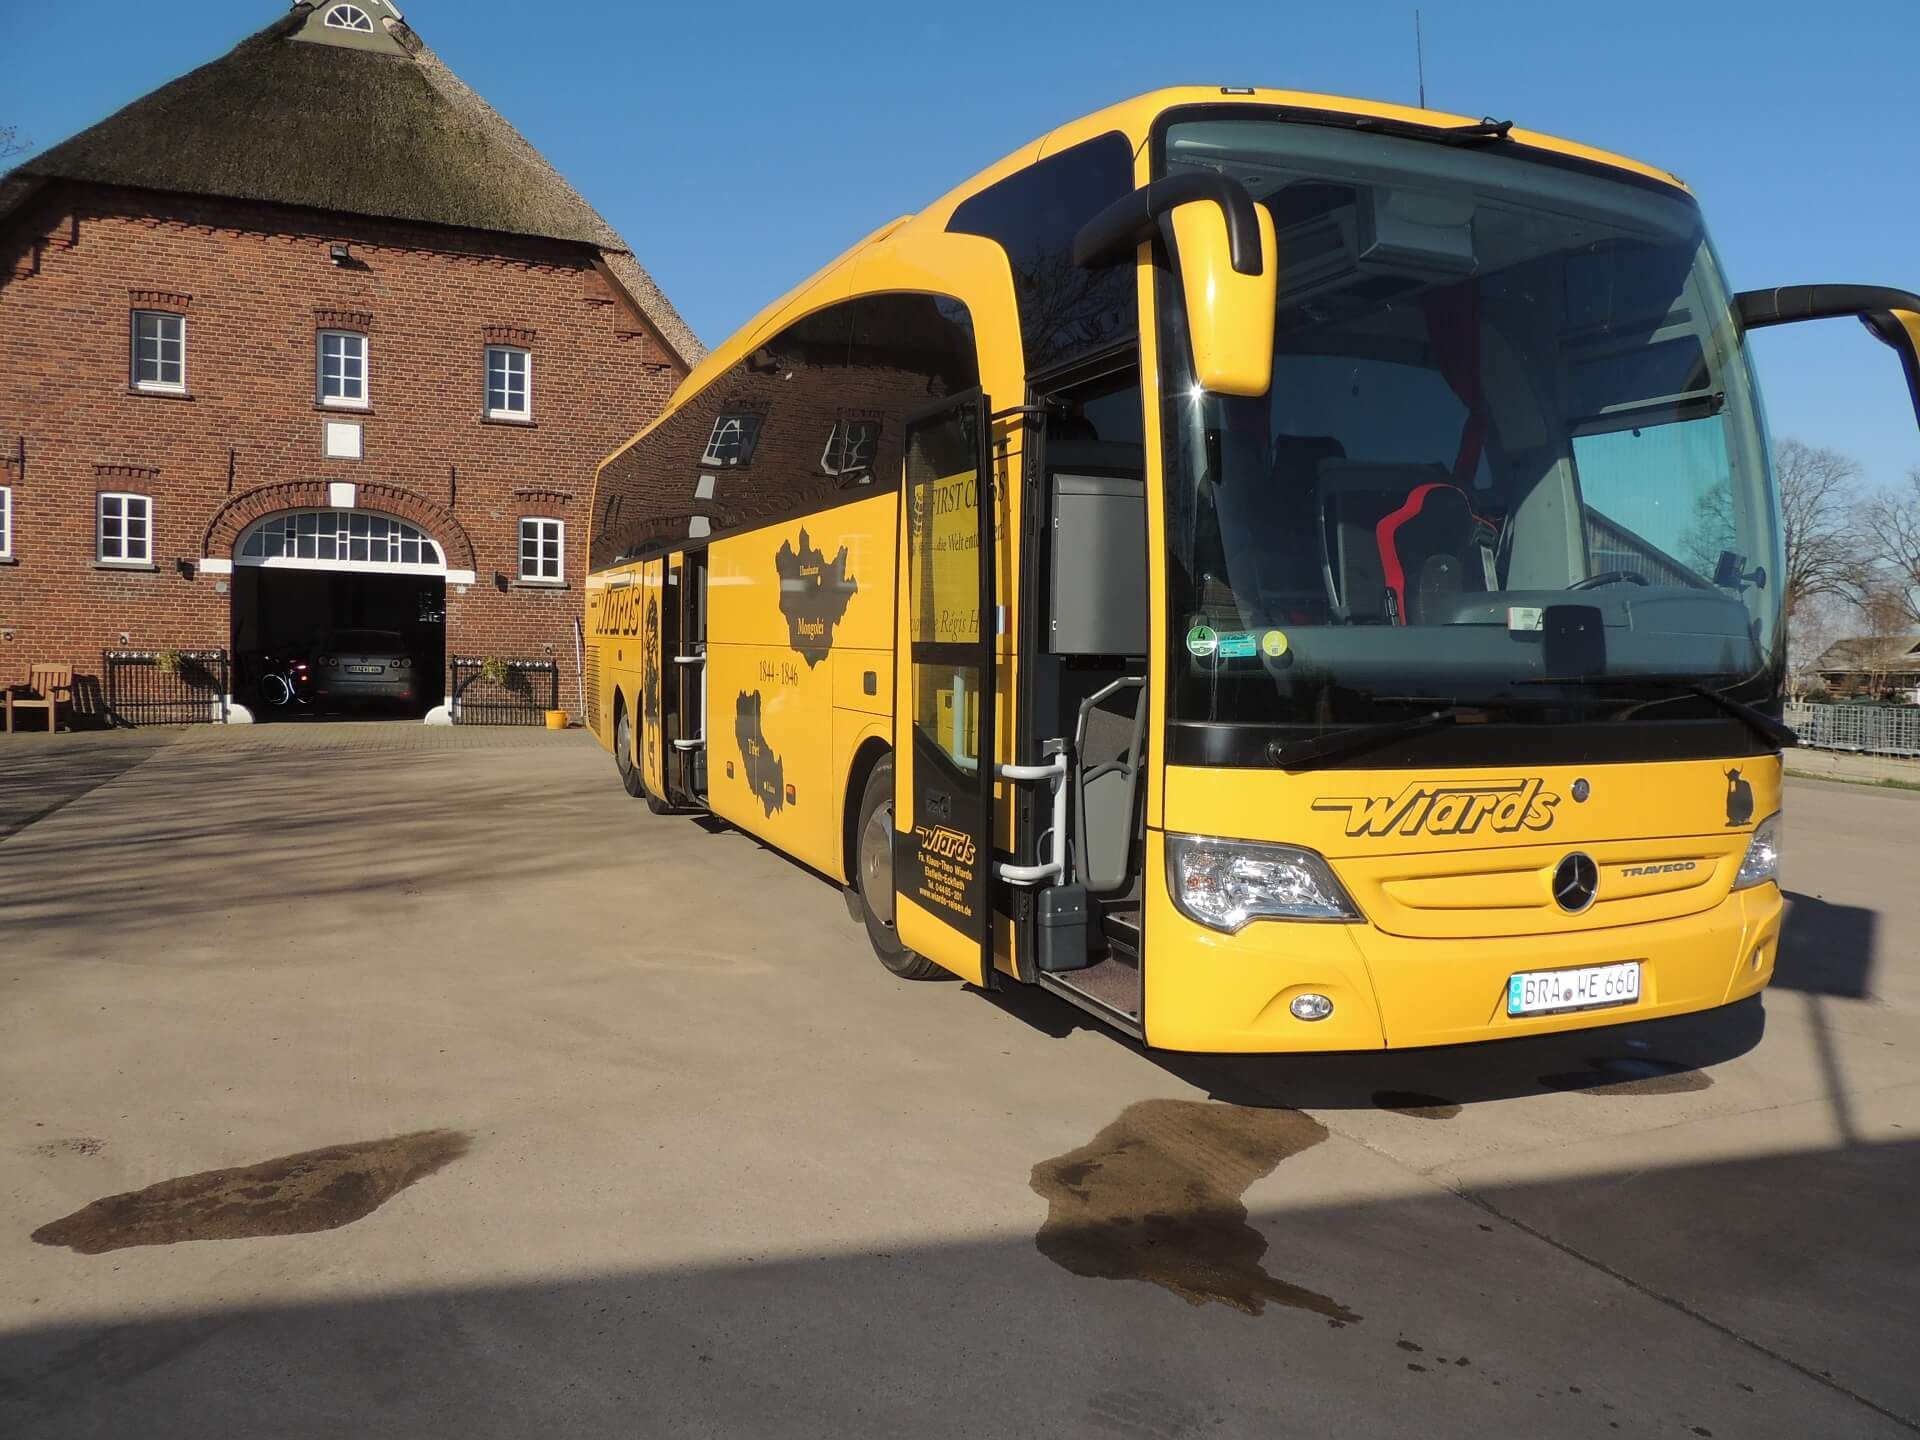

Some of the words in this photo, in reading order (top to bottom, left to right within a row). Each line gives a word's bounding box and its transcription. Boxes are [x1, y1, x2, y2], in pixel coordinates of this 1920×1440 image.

[932, 481, 963, 515] FIRST
[948, 533, 964, 552] Welt
[797, 617, 825, 641] Mongolei
[940, 608, 967, 641] Régis
[1198, 627, 1206, 640] 4
[759, 660, 775, 682] 1844
[781, 661, 799, 687] 1846
[1311, 778, 1560, 837] Wiards
[915, 825, 976, 866] Wiards
[1621, 861, 1696, 878] TRAVEGO
[1525, 977, 1560, 1005] BRA
[1577, 973, 1600, 999] WE
[1604, 969, 1636, 996] 660
